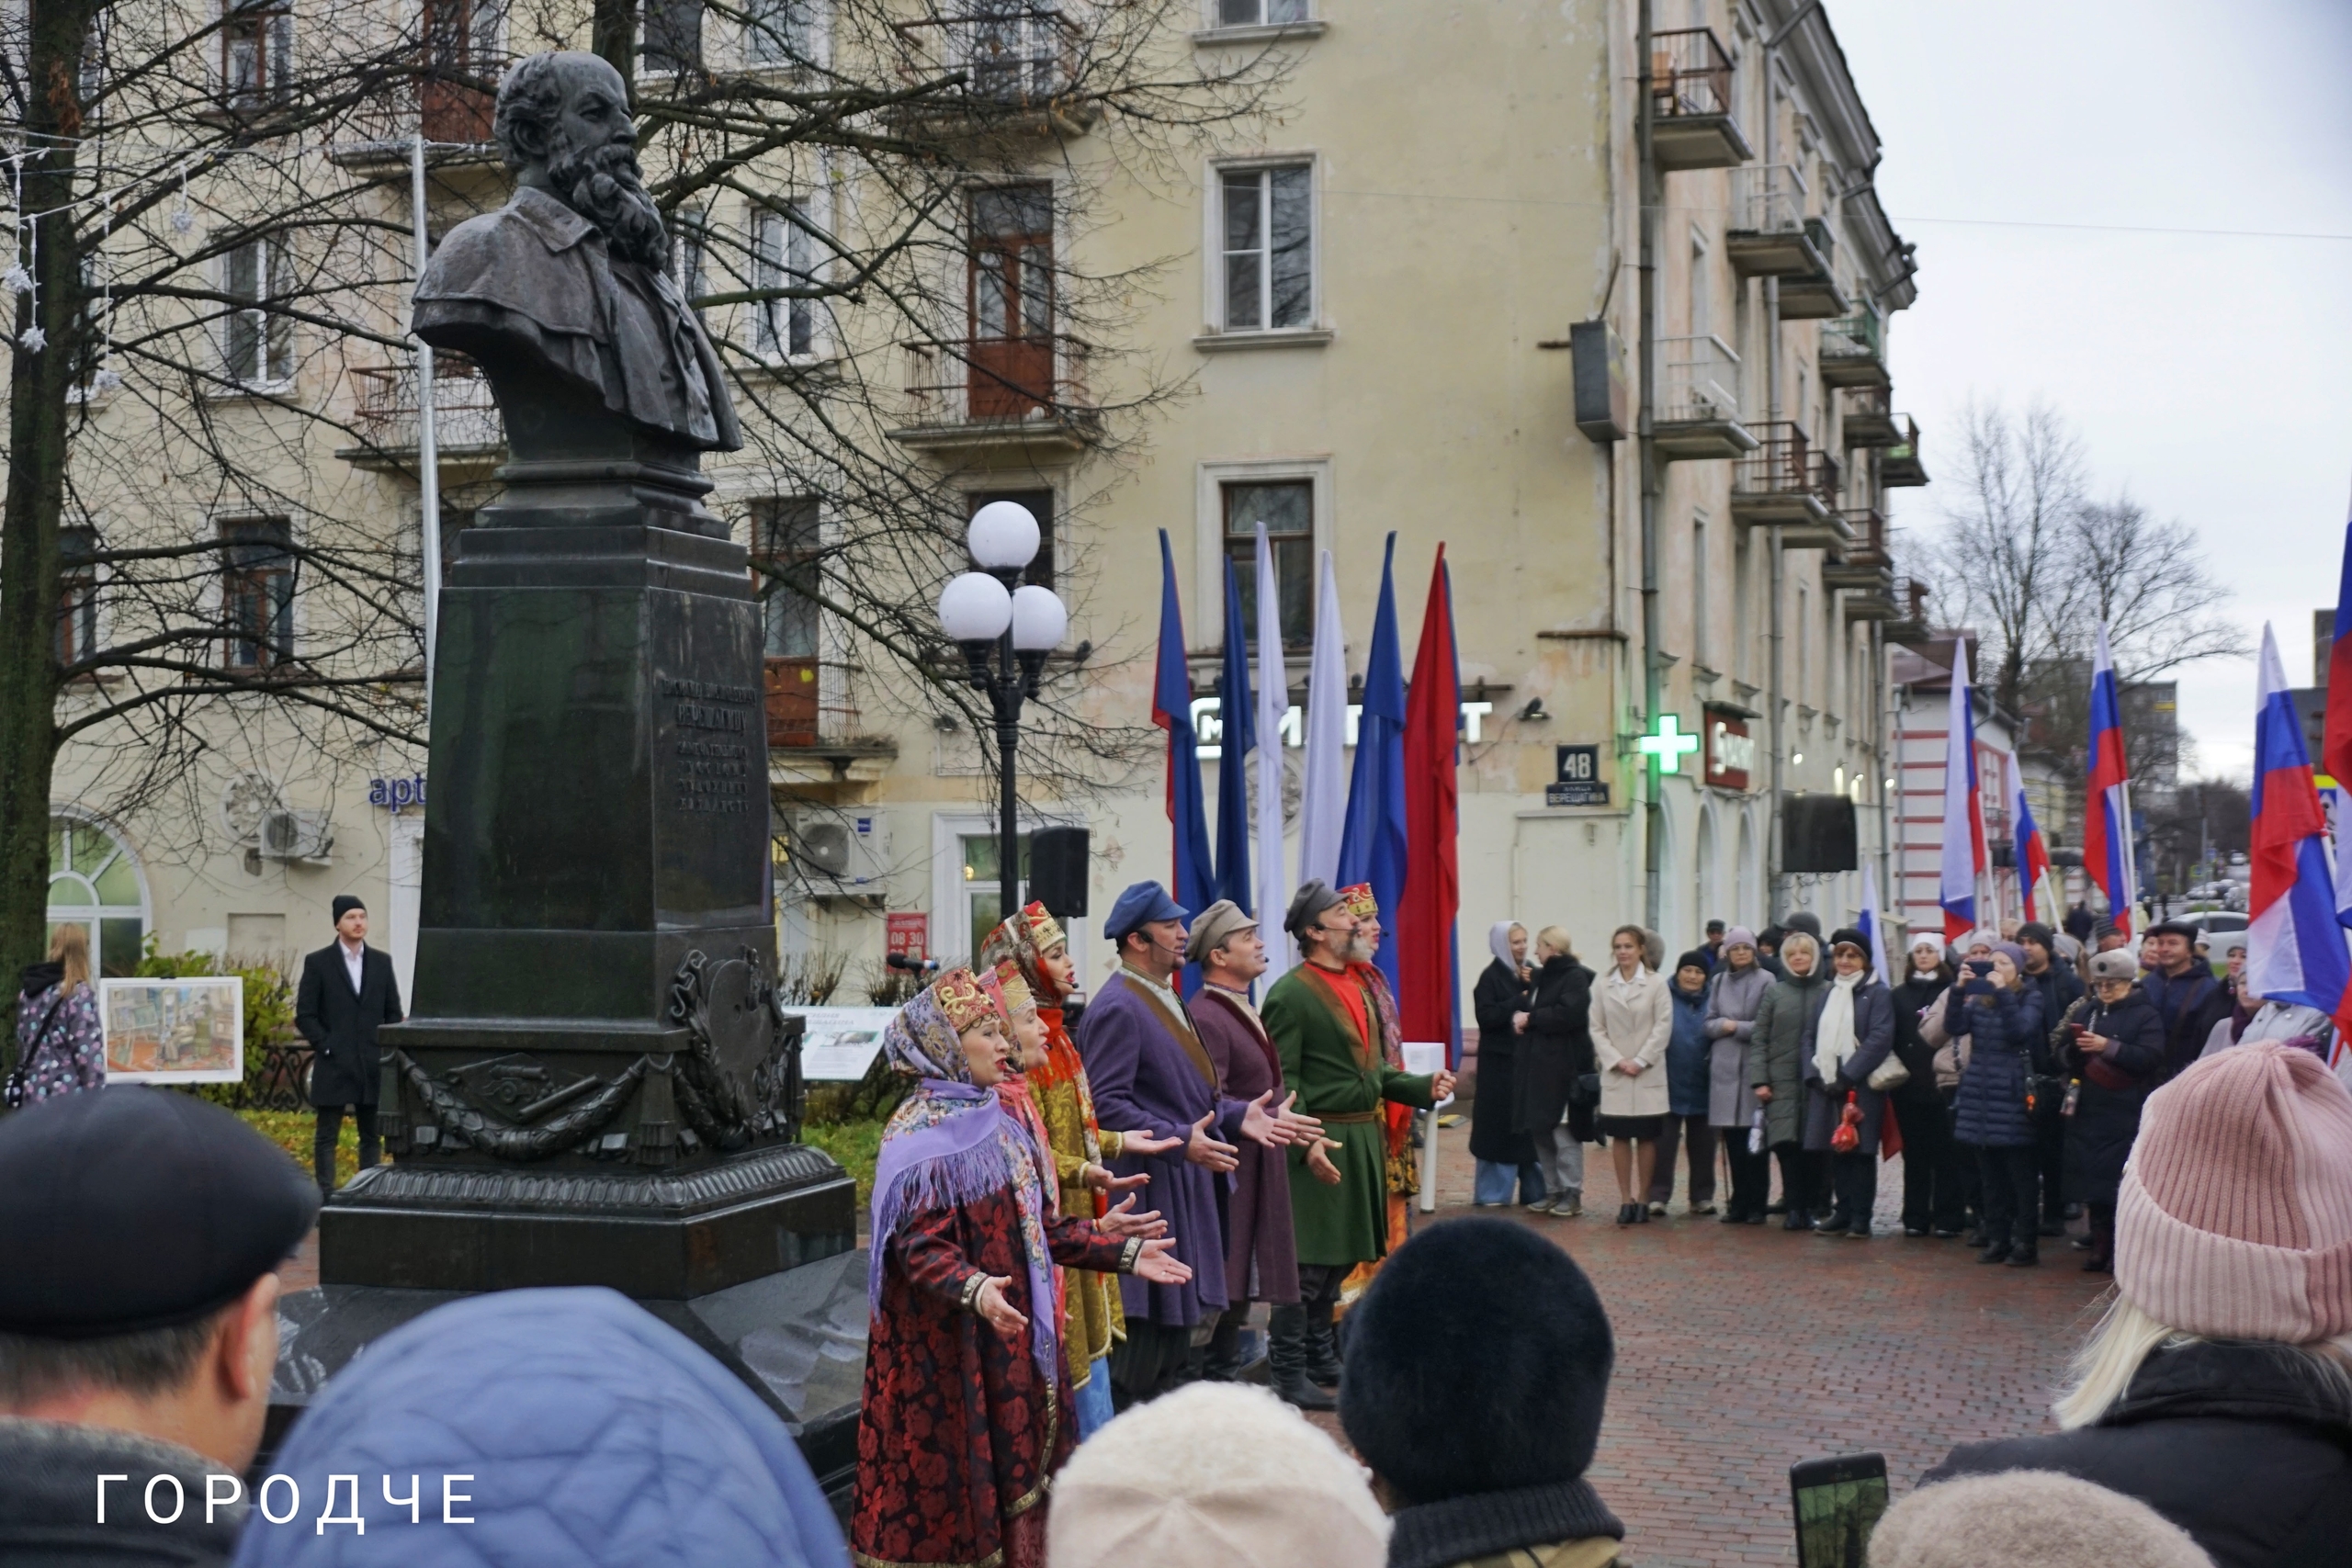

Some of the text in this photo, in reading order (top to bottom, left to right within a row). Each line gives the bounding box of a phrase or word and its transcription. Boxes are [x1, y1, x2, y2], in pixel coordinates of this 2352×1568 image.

[1563, 752, 1591, 779] 48
[891, 931, 923, 945] 08 30
